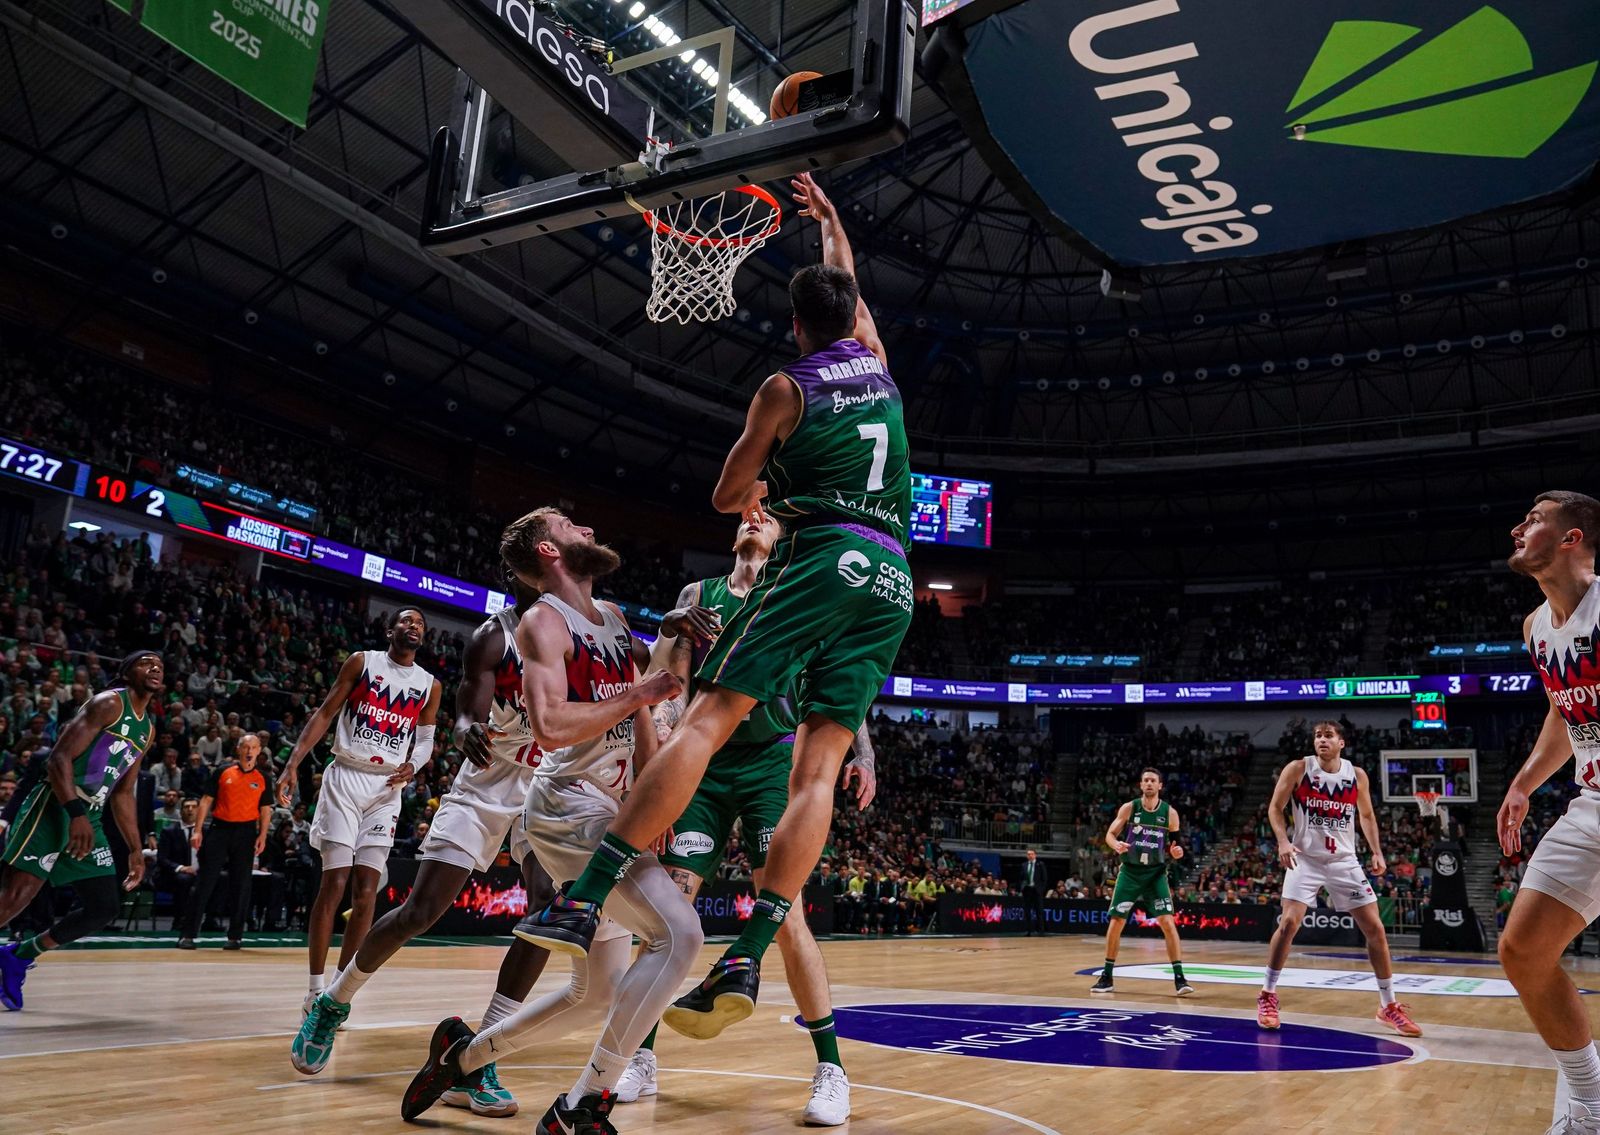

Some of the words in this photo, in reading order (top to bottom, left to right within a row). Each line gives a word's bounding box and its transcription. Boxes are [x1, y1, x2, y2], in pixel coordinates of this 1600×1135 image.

[231, 0, 255, 17] CUP
[209, 10, 263, 59] 2025
[1068, 0, 1273, 253] Unicaja
[0, 443, 63, 482] 7:27
[857, 423, 888, 492] 7
[96, 475, 126, 503] 10
[145, 489, 166, 518] 2
[916, 502, 940, 515] 7:27
[240, 516, 281, 540] KOSNER
[226, 525, 279, 551] BASKONIA
[875, 573, 897, 592] DEL
[1356, 680, 1411, 695] UNICAJA
[1448, 676, 1461, 694] 3
[1489, 675, 1532, 692] 7:27
[1415, 692, 1439, 702] 7:27
[1415, 703, 1440, 721] 10
[1324, 836, 1337, 855] 4
[1043, 908, 1063, 922] TU
